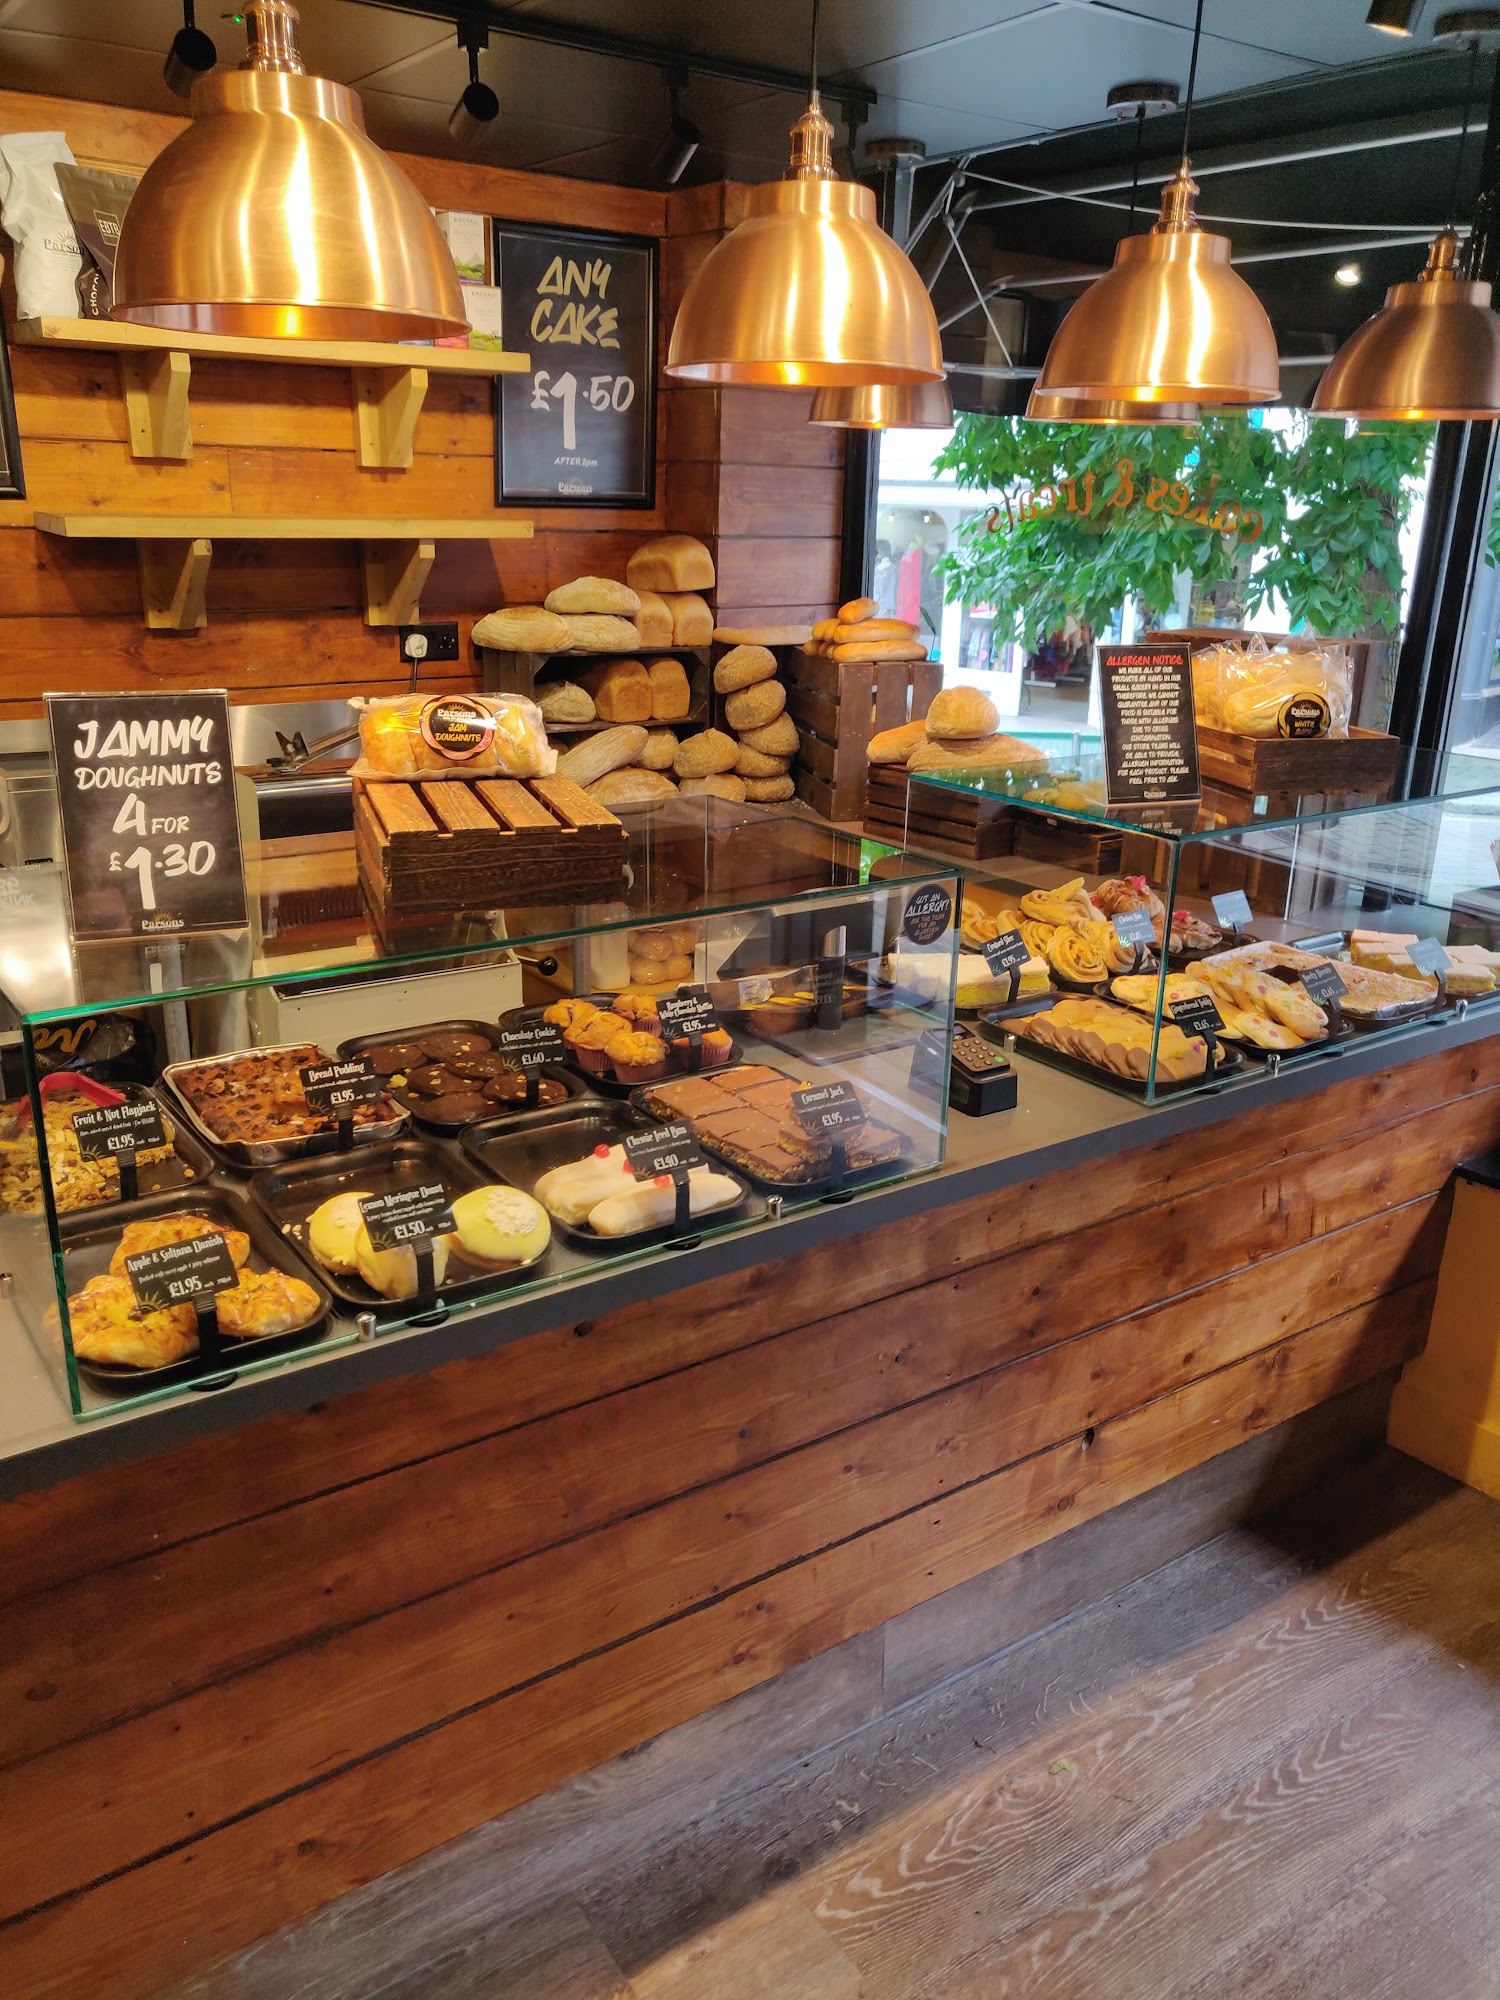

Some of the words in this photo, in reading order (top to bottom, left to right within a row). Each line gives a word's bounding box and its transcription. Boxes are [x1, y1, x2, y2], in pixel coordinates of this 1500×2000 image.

[536, 256, 611, 300] ANY
[530, 298, 620, 349] CAKE
[530, 370, 635, 450] £1.50
[554, 456, 581, 466] AFTER
[581, 458, 598, 466] 2pm
[558, 480, 593, 494] Parsons
[1106, 655, 1150, 666] ALLERGEN
[437, 708, 476, 718] Parsons
[74, 715, 214, 758] JAMMY
[448, 723, 467, 732] JAM
[434, 733, 482, 742] DOUGHNUTS
[74, 762, 222, 790] DOUGHNUTS
[112, 792, 146, 836] 4
[151, 816, 190, 834] FOR
[109, 840, 216, 910] £1.30
[904, 898, 950, 918] ALLERGY?
[916, 894, 929, 904] GOT
[930, 893, 940, 902] AN
[142, 918, 184, 930] Parsons
[502, 1030, 534, 1043] Chocolate
[534, 1027, 556, 1039] Cookie
[682, 1020, 700, 1032] £1.95
[522, 1052, 544, 1065] £1.60
[308, 1066, 333, 1082] Bread
[333, 1063, 365, 1078] Pudding
[330, 1089, 355, 1104] £1.95
[801, 1088, 828, 1104] Caramel
[829, 1085, 844, 1098] Jack
[73, 1114, 96, 1128] Fruit
[96, 1112, 102, 1121] &
[104, 1109, 120, 1122] Nut
[121, 1101, 156, 1119] Flapjack
[822, 1112, 843, 1126] £1.95
[108, 1133, 134, 1150] £1.95
[626, 1132, 654, 1148] Classic
[653, 1127, 670, 1142] Iced
[669, 1126, 687, 1138] Bun
[654, 1154, 678, 1170] £1.40
[360, 1199, 384, 1213] Lemon
[384, 1192, 420, 1207] Meringue
[394, 1220, 425, 1239] £1.50
[127, 1255, 151, 1272] Apple
[152, 1252, 160, 1262] &
[160, 1246, 193, 1262] Sultana
[192, 1234, 223, 1253] Danish
[169, 1276, 202, 1297] £1.95
